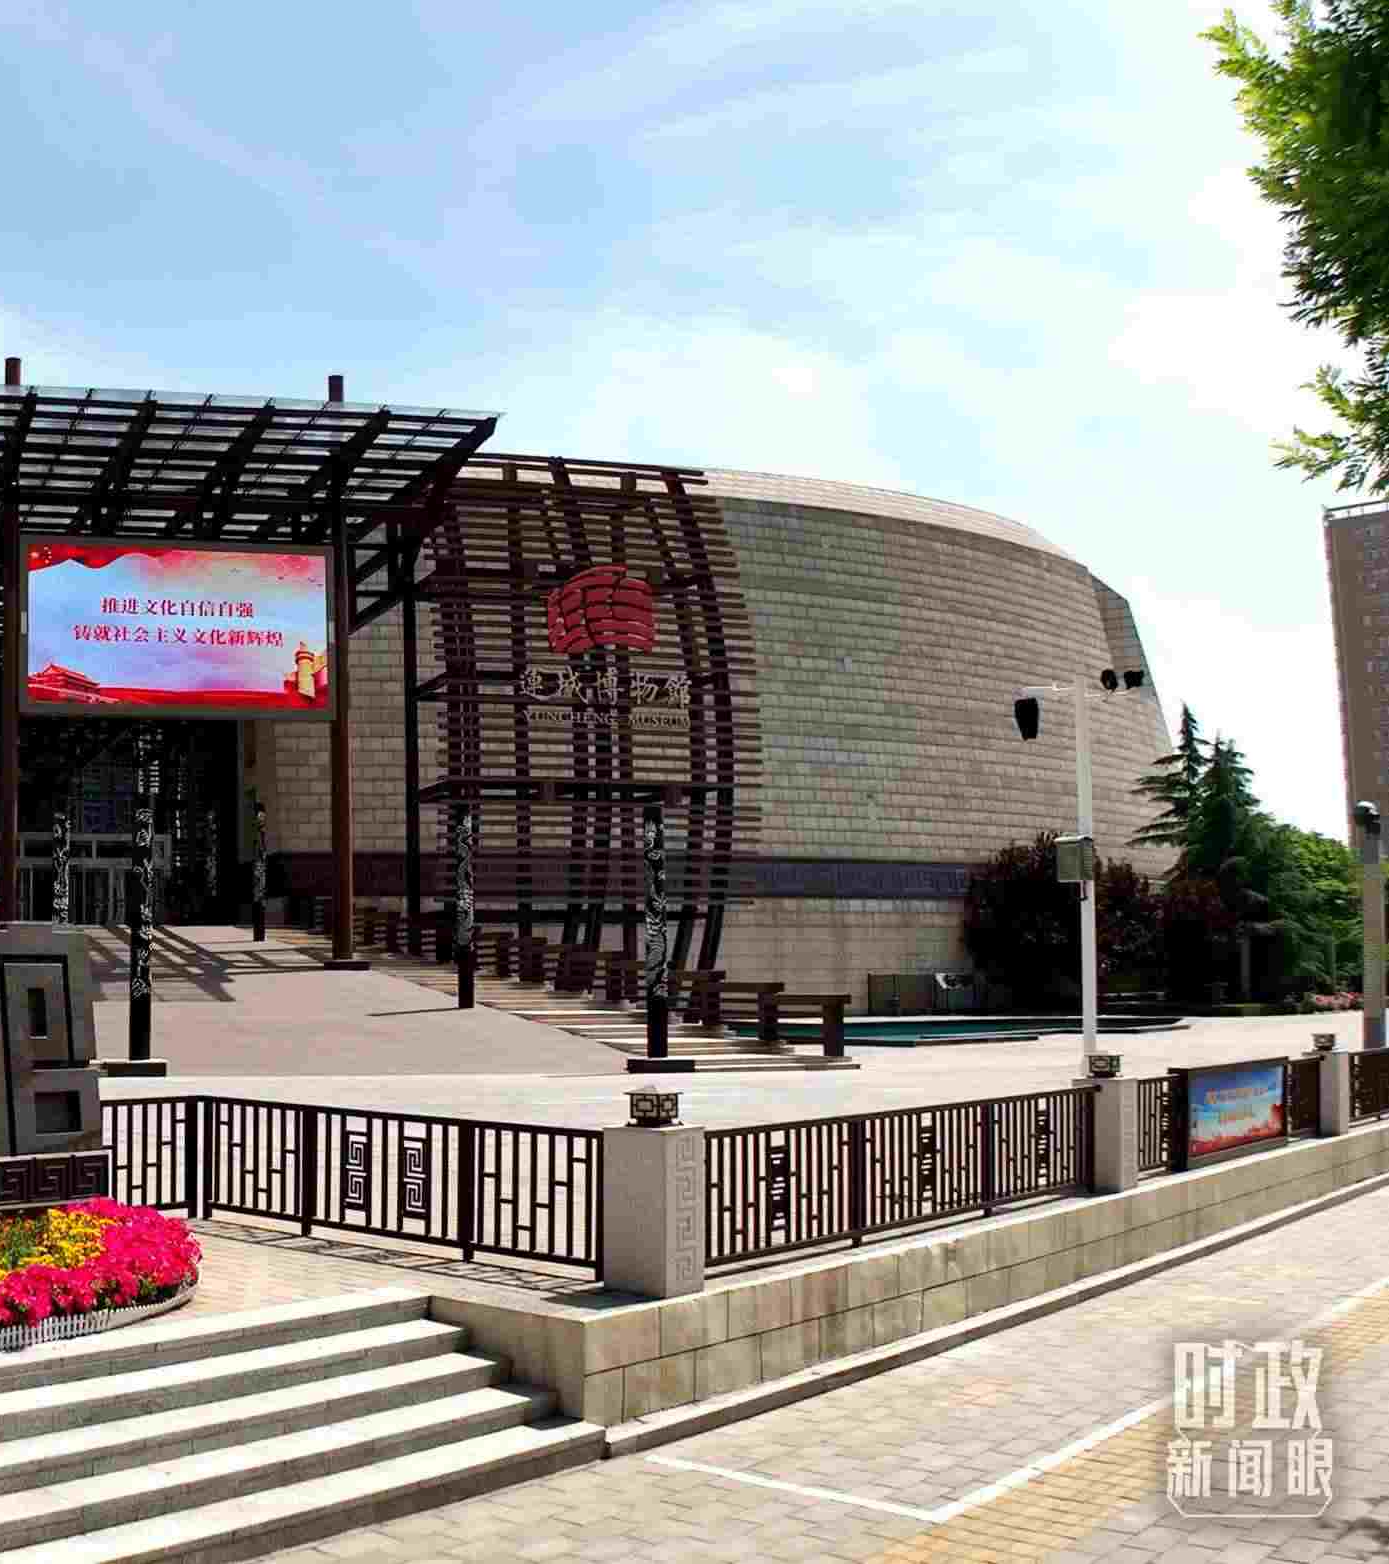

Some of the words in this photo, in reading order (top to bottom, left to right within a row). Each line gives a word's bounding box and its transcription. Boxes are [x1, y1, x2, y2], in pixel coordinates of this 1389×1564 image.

[100, 597, 254, 618] 推进文化自信自强
[73, 624, 284, 648] 铸就社会主义文化新辉煌
[523, 709, 615, 725] YUNCHENG
[628, 711, 691, 729] MUSEUM
